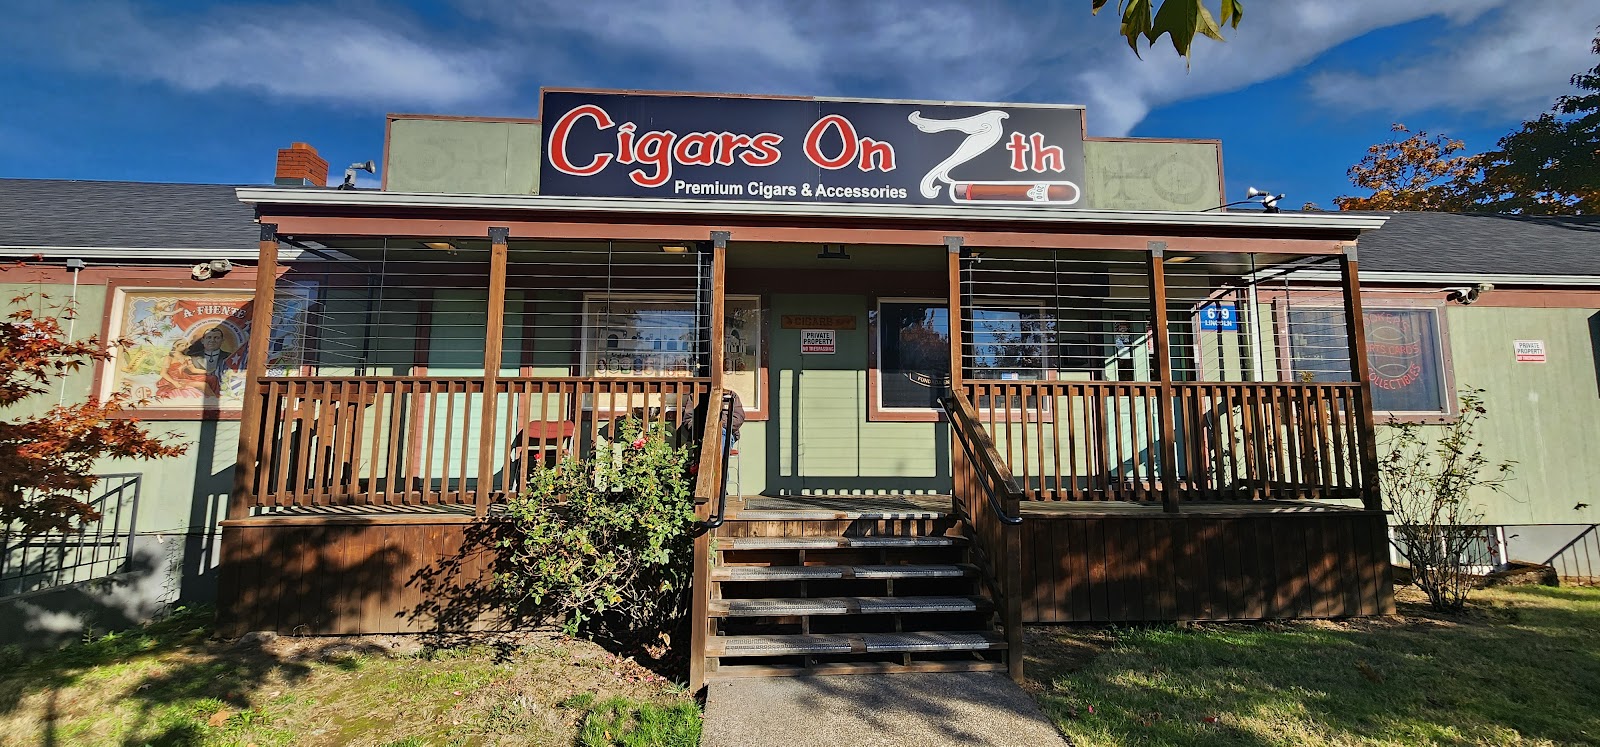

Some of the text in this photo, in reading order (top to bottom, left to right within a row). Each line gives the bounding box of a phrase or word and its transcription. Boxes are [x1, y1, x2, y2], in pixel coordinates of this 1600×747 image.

[548, 104, 784, 188] Cigars
[803, 114, 897, 173] On
[674, 180, 908, 199] Premium Cigars & Accessories
[197, 305, 247, 319] FUENTE
[1207, 307, 1230, 320] 679
[1204, 319, 1233, 327] LINCOLN
[1388, 345, 1420, 355] CARDS
